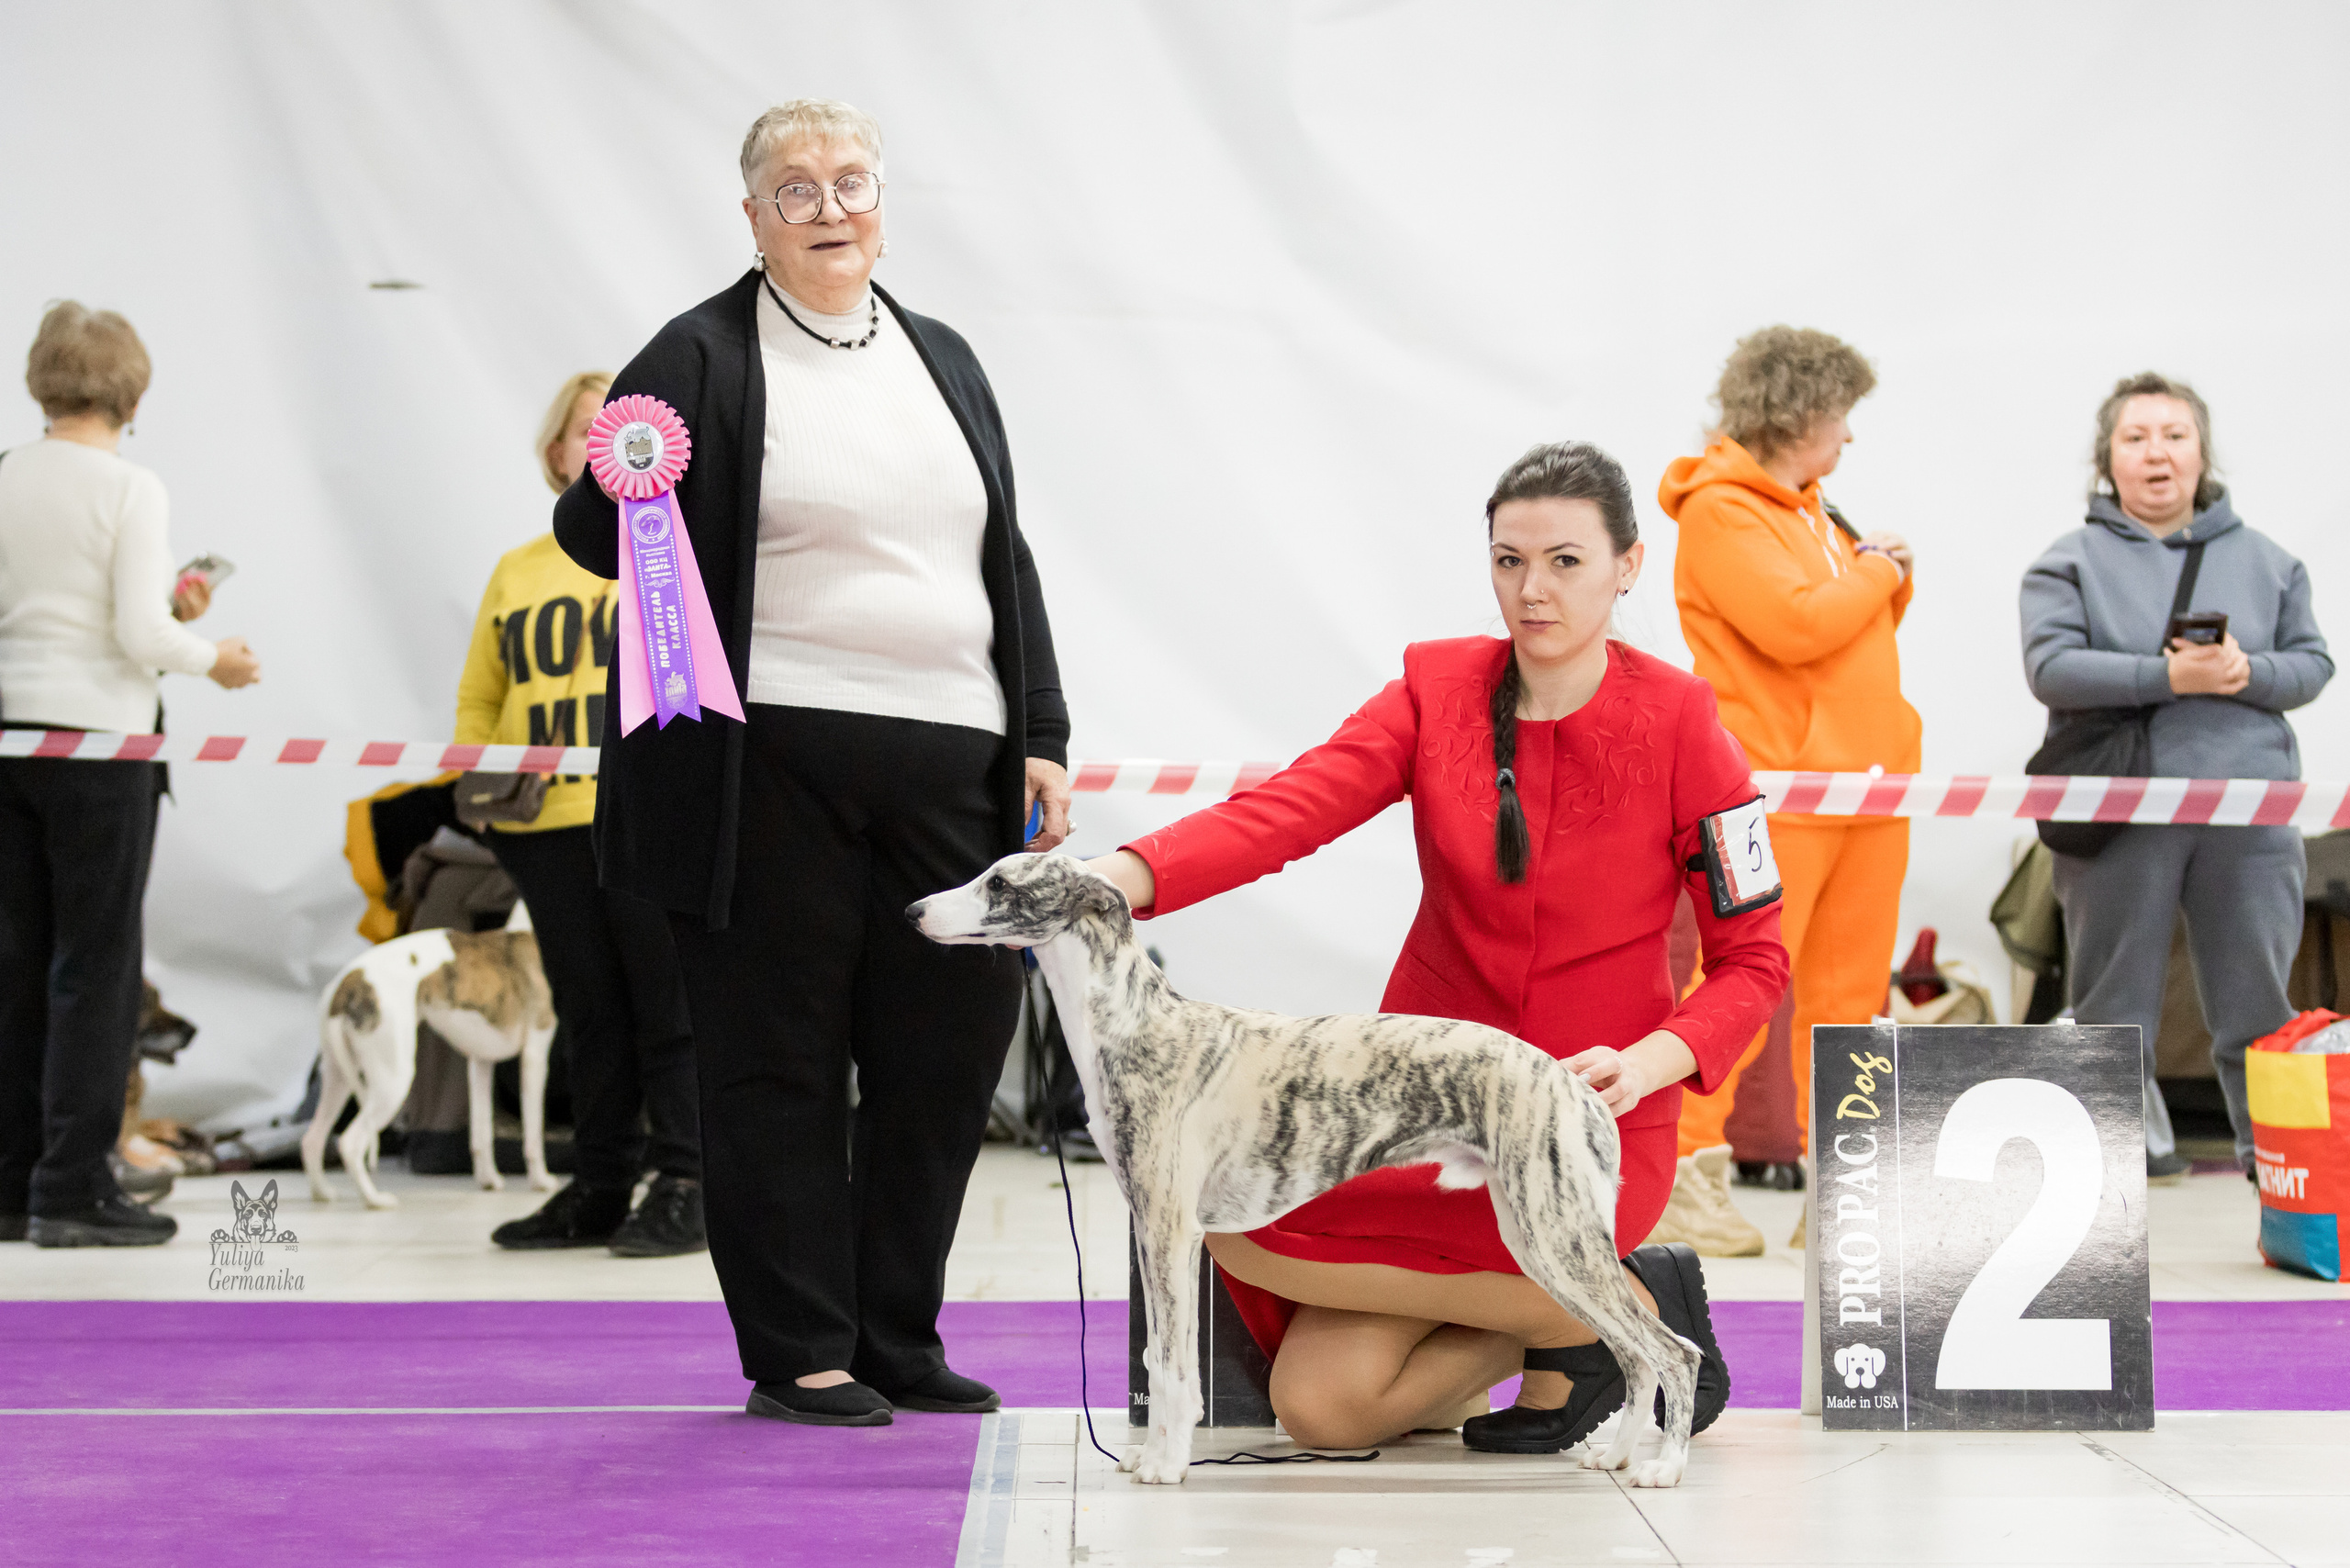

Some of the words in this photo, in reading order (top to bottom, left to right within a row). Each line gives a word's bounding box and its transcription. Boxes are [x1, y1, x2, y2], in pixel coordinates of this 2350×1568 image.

[650, 590, 671, 668] ПОБЕДИТЕЛЬ
[666, 604, 682, 649] КЛАССА
[1748, 816, 1762, 873] 5
[1836, 1051, 1893, 1120] Dog
[1835, 1134, 1879, 1225] PAC
[1934, 1077, 2112, 1391] 2
[1839, 1230, 1883, 1327] PRO
[1827, 1394, 1856, 1409] Made
[1860, 1394, 1871, 1409] in
[1874, 1395, 1899, 1409] USA
